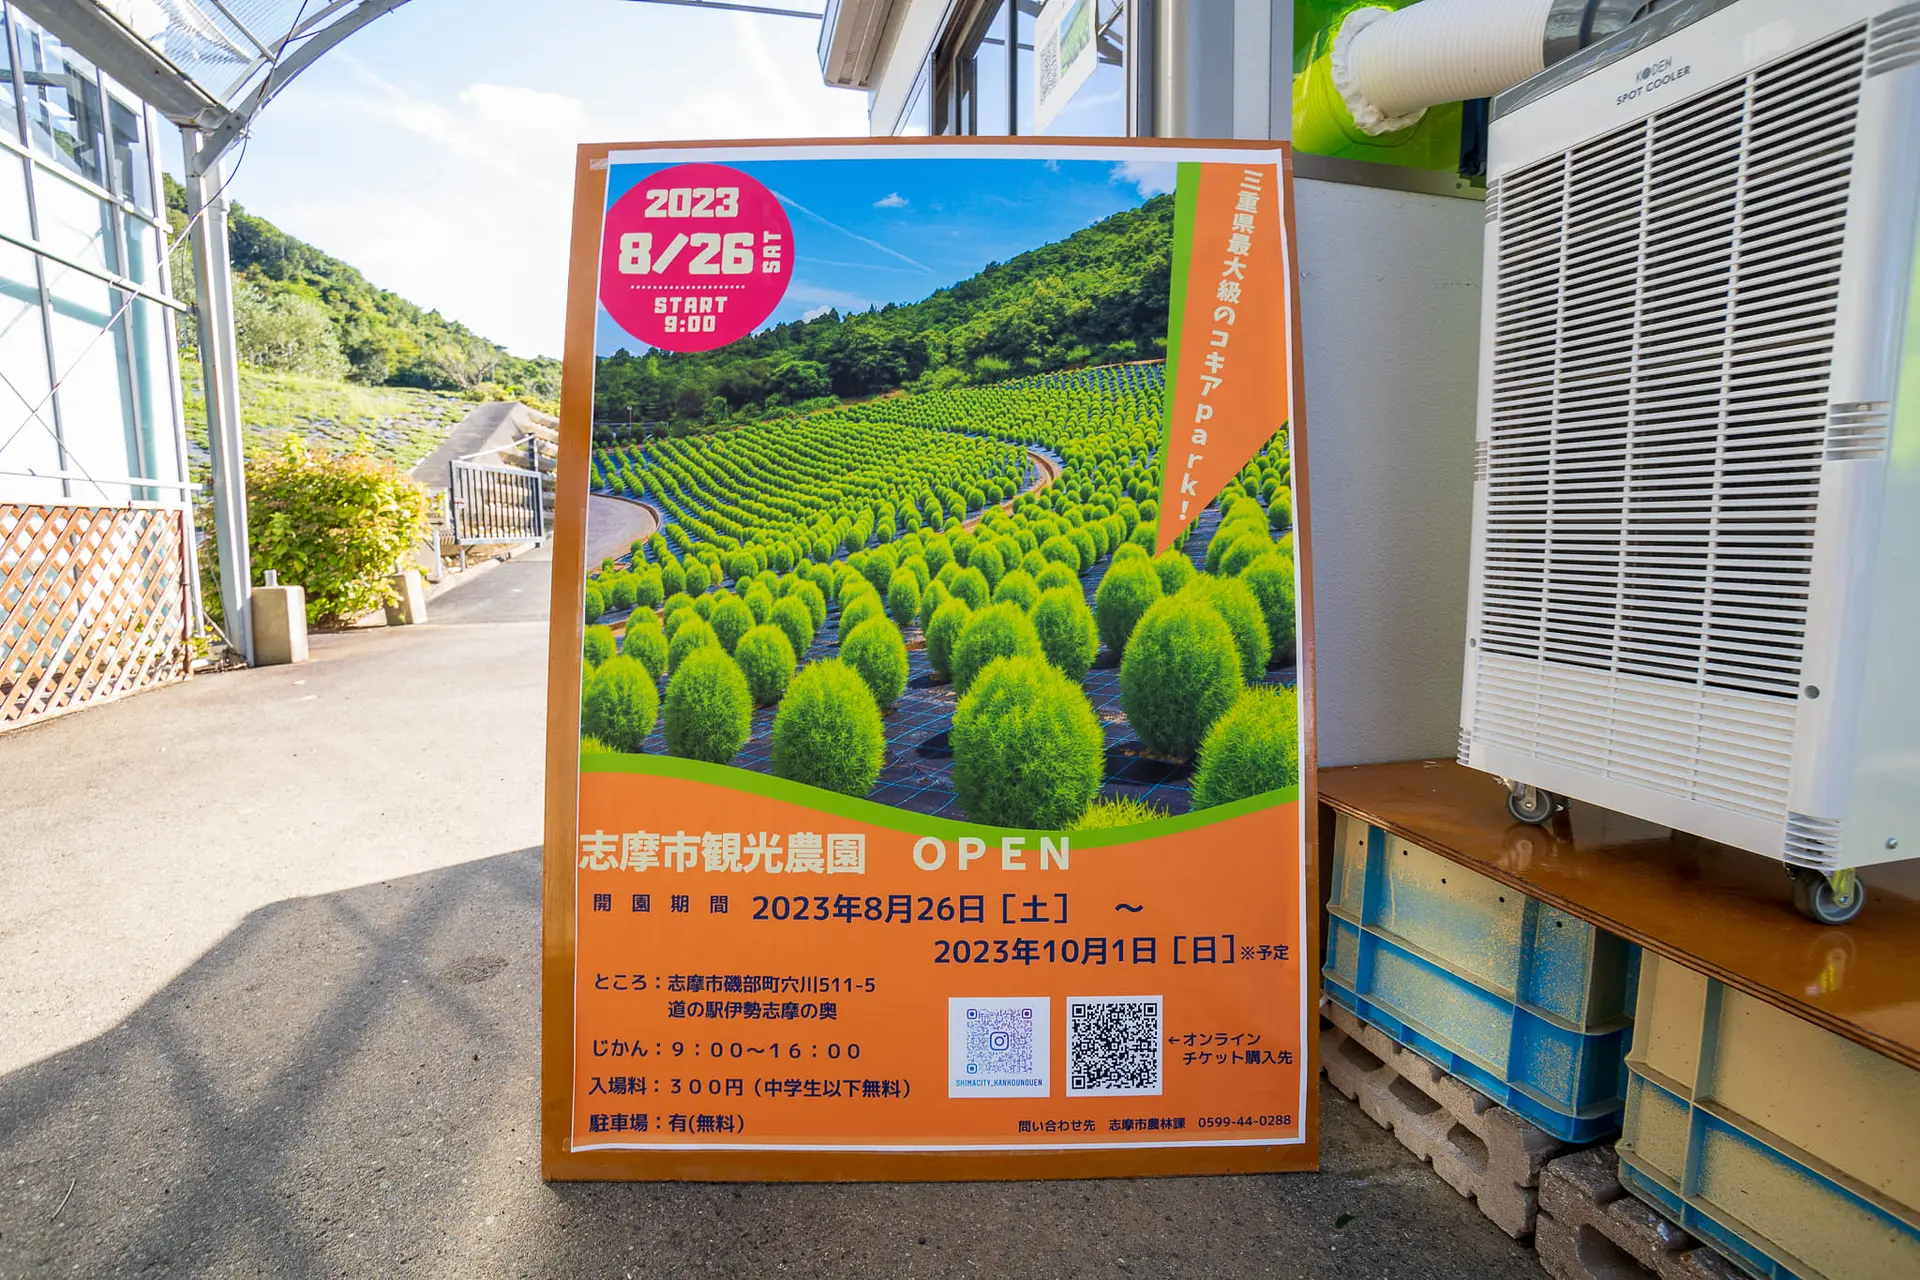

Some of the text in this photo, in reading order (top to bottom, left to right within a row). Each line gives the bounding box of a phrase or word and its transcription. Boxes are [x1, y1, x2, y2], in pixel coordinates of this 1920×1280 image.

[1616, 65, 1692, 106] SPOT COOLER
[644, 187, 740, 218] 2023
[618, 232, 755, 275] 8/26
[762, 230, 782, 274] SAT
[654, 296, 728, 314] START
[664, 315, 716, 333] 9:00
[579, 830, 1070, 875] 志摩市観光農園 OPEN
[668, 1001, 838, 1020] 道の駅伊勢志摩の奥
[1183, 1032, 1261, 1046] オンライン
[1182, 1050, 1293, 1065] チケット購入先
[1018, 1115, 1291, 1133] 問い合わせ先 志摩市農林課 0599-44-0288
